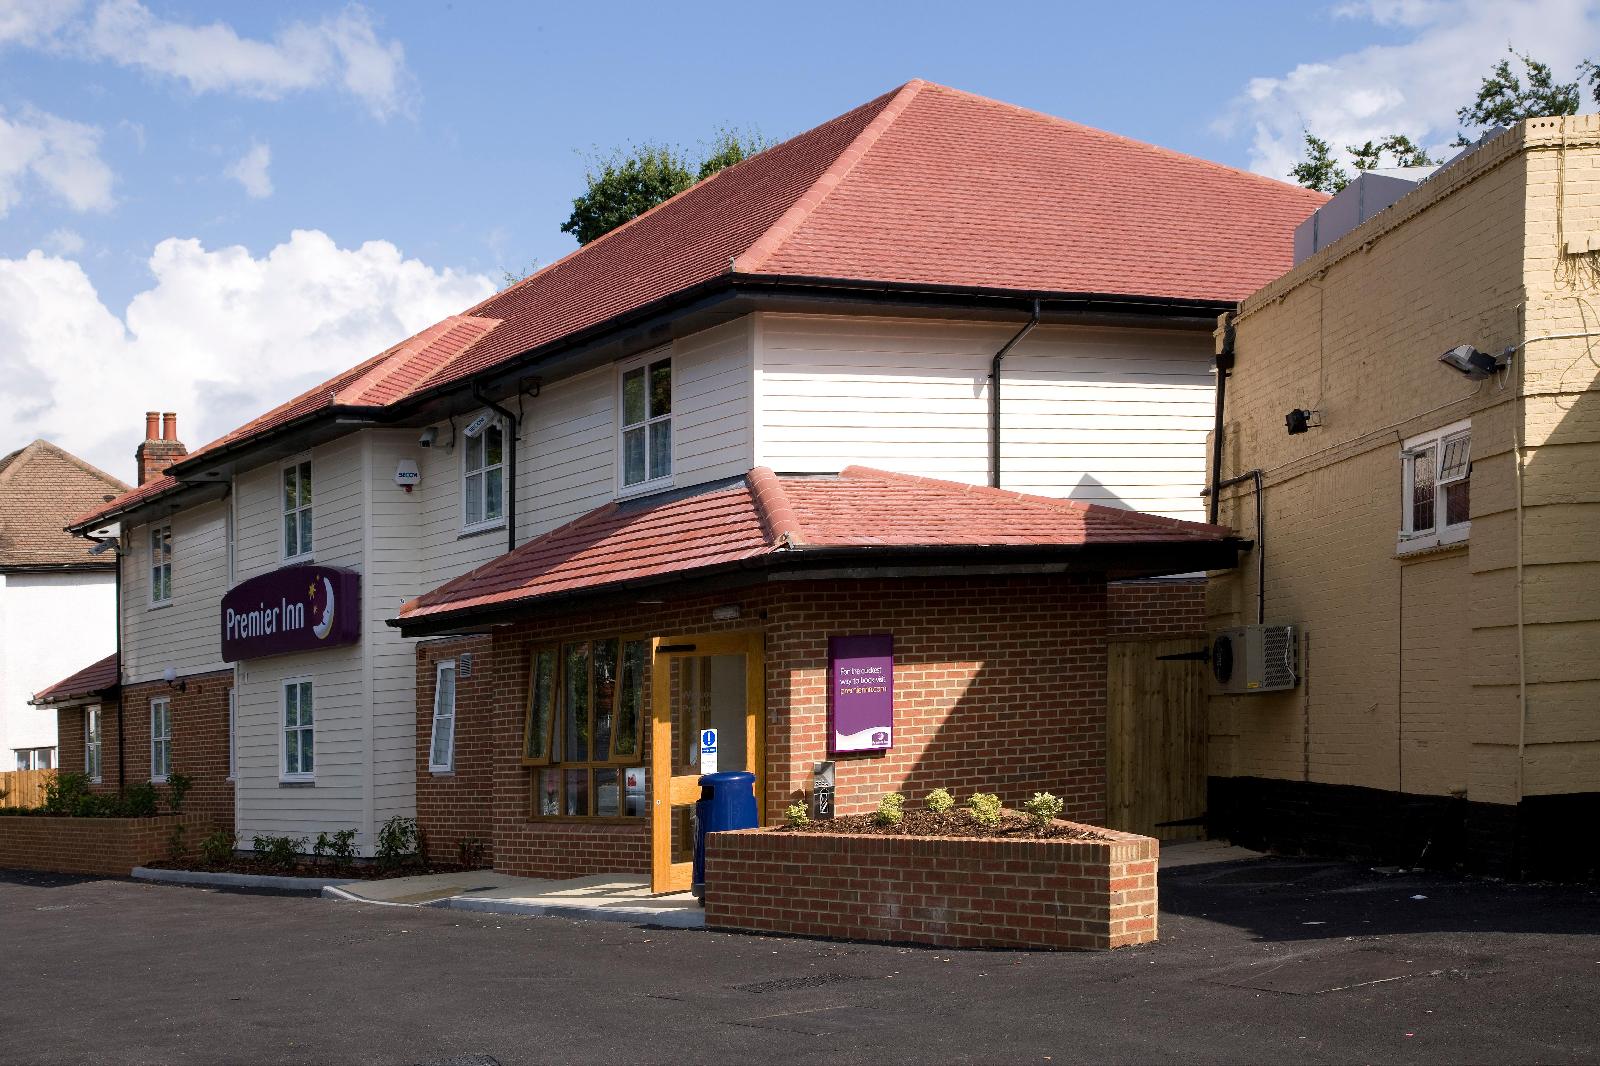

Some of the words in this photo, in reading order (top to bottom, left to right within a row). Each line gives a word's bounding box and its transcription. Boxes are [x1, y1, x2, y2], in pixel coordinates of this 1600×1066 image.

[226, 602, 279, 640] Premier
[282, 597, 304, 631] Inn
[840, 667, 851, 675] For
[851, 667, 860, 675] the
